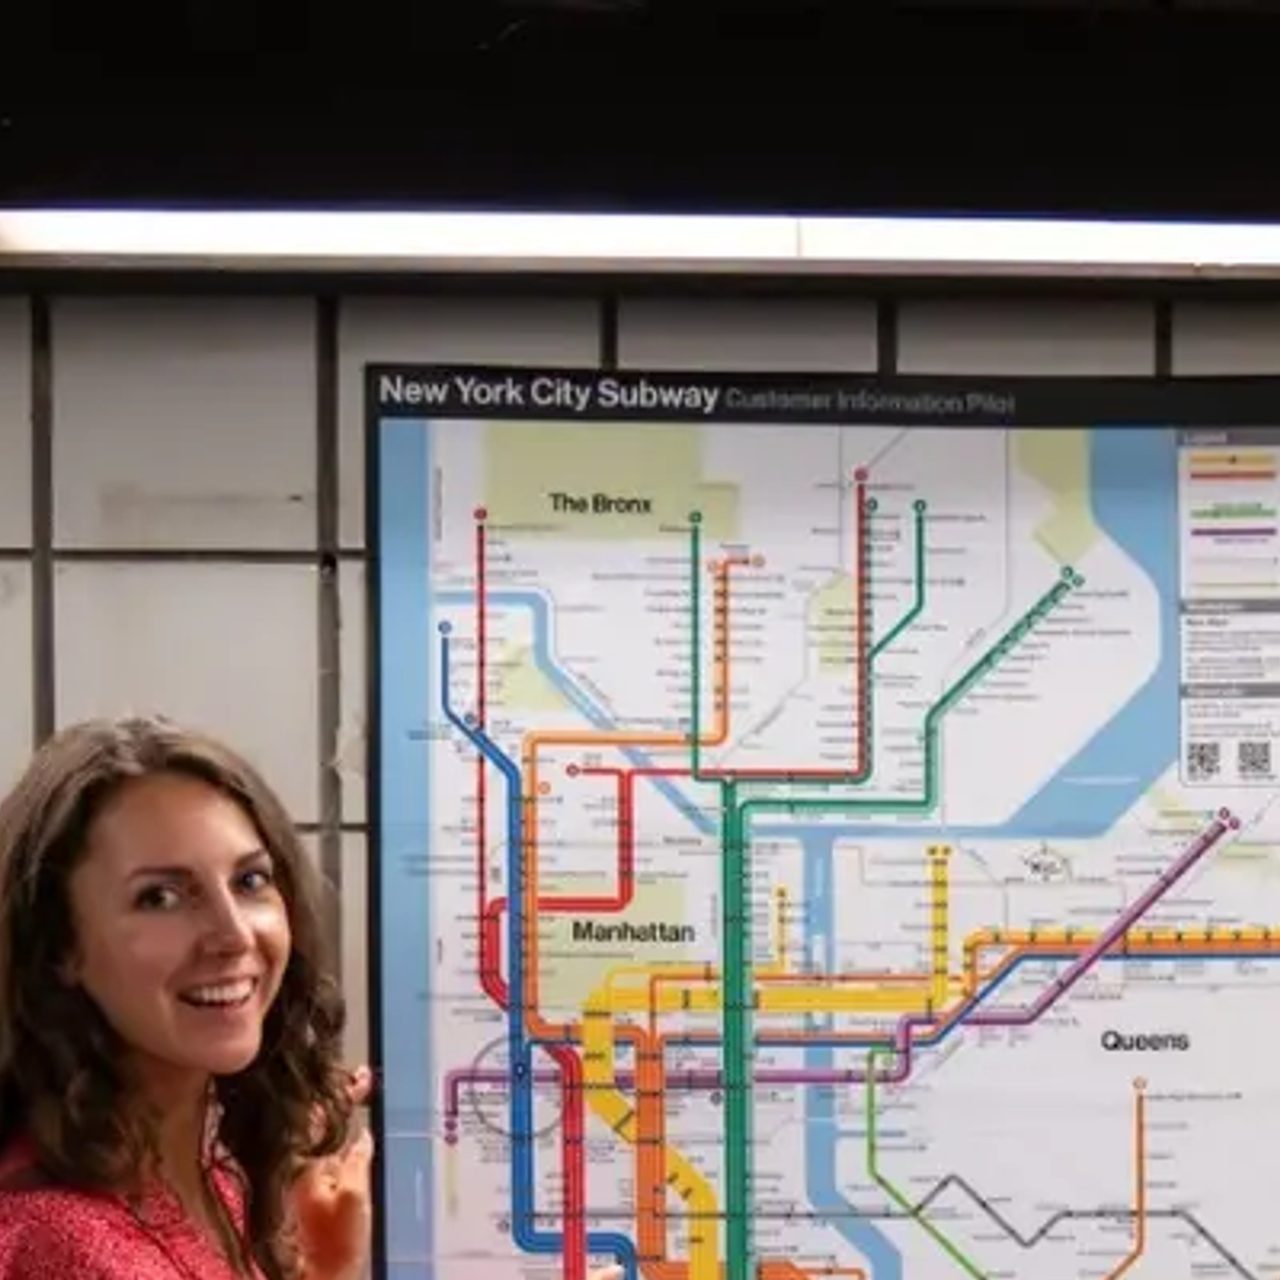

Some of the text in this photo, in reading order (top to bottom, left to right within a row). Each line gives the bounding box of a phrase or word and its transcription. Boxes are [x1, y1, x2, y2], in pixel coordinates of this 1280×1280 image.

[379, 375, 448, 403] New
[455, 376, 524, 405] York
[531, 377, 591, 412] City
[597, 378, 720, 414] Subway
[548, 493, 651, 514] The Bronx
[572, 921, 695, 942] Manhattan
[1101, 1030, 1190, 1052] Queens
